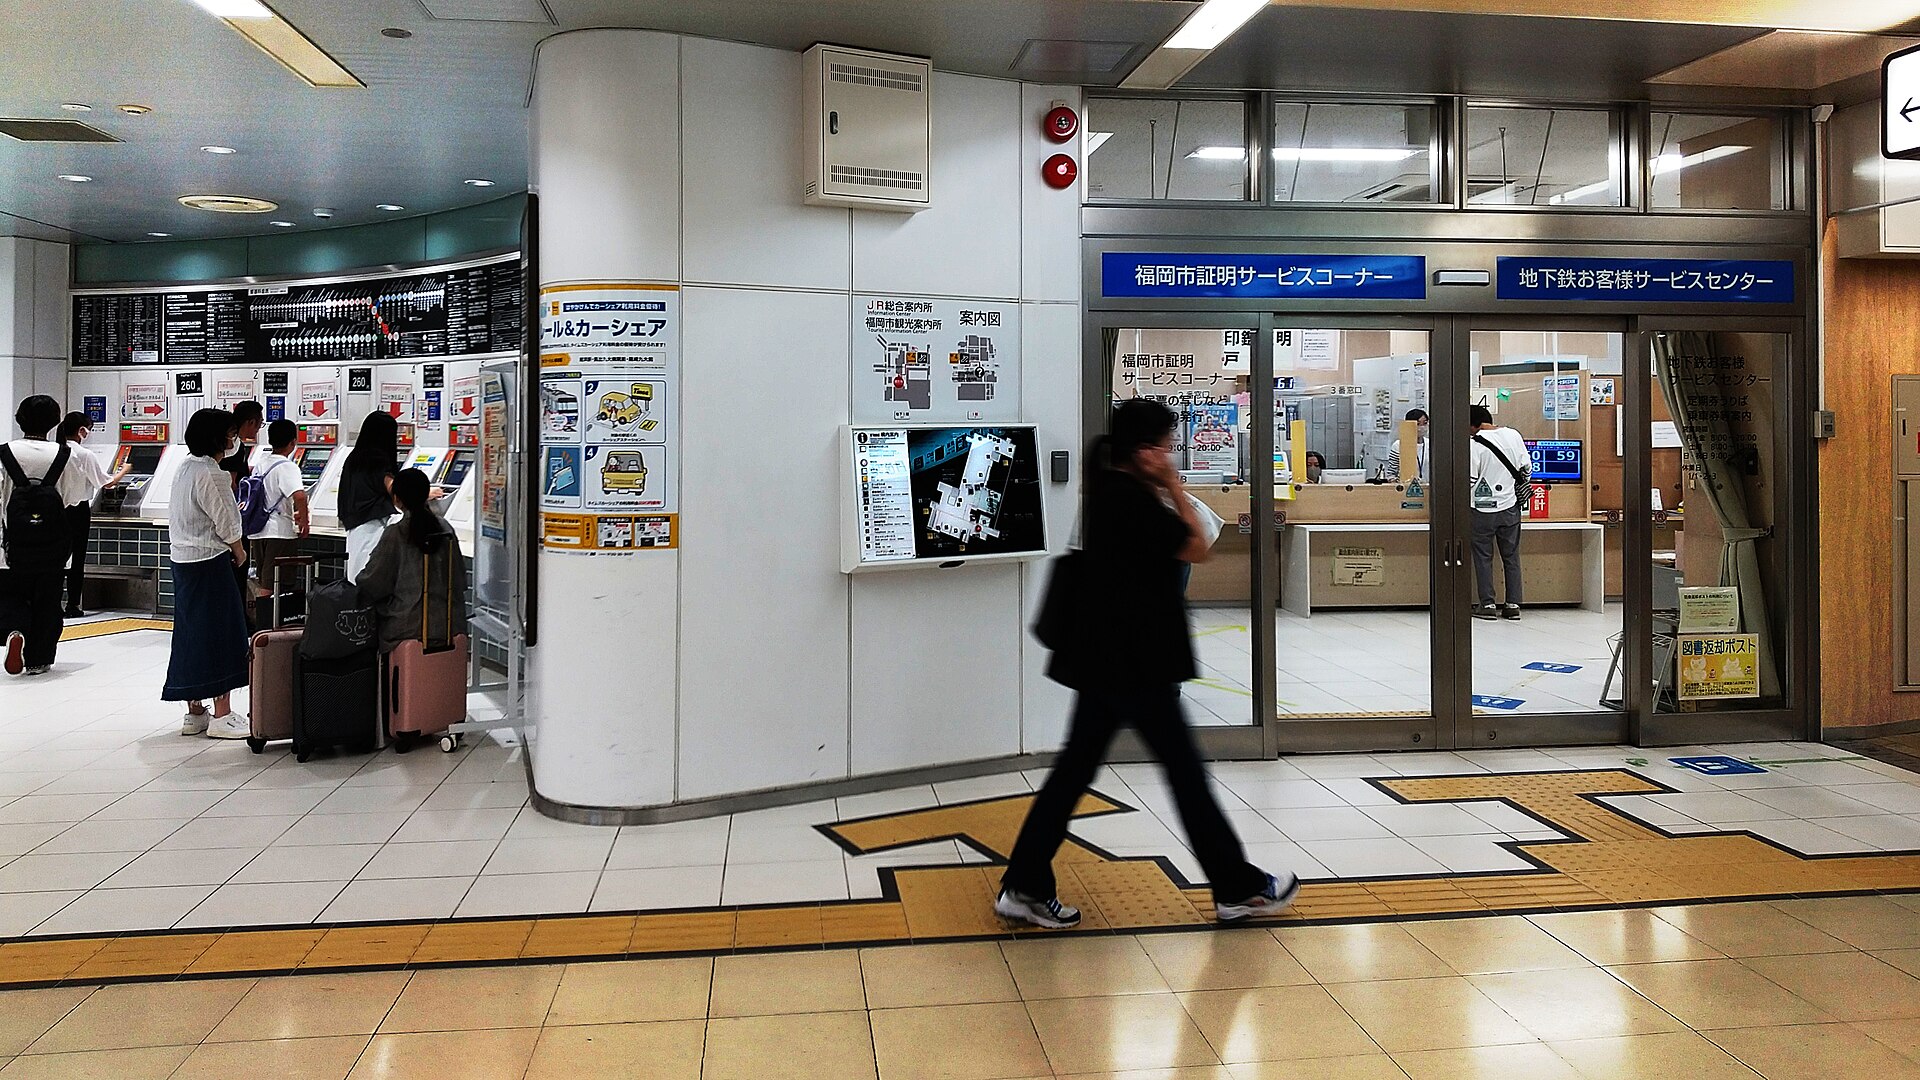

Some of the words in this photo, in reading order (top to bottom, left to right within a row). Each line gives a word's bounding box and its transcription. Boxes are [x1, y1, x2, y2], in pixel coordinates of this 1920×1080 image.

[1134, 264, 1393, 288] 福岡市証明サービスコーナー
[1519, 268, 1774, 292] 地下鉄お客様サービスセンター
[865, 317, 942, 330] 福岡市観光案内所
[959, 310, 1001, 327] 案内図
[1122, 354, 1194, 368] 福岡市証明
[1667, 356, 1745, 369] 地下鉄お客様
[253, 370, 259, 380] 2
[336, 367, 341, 379] 3
[1122, 373, 1237, 385] サービスコーナー
[181, 381, 196, 391] 260
[352, 376, 366, 387] 260
[1668, 373, 1770, 387] サービスセンター
[587, 383, 594, 392] 2
[1331, 386, 1362, 394] 3番窓口
[587, 448, 594, 457] 4
[1557, 450, 1575, 461] 59
[1534, 487, 1546, 511] 会計
[1682, 639, 1756, 655] 図書返却ポスト
